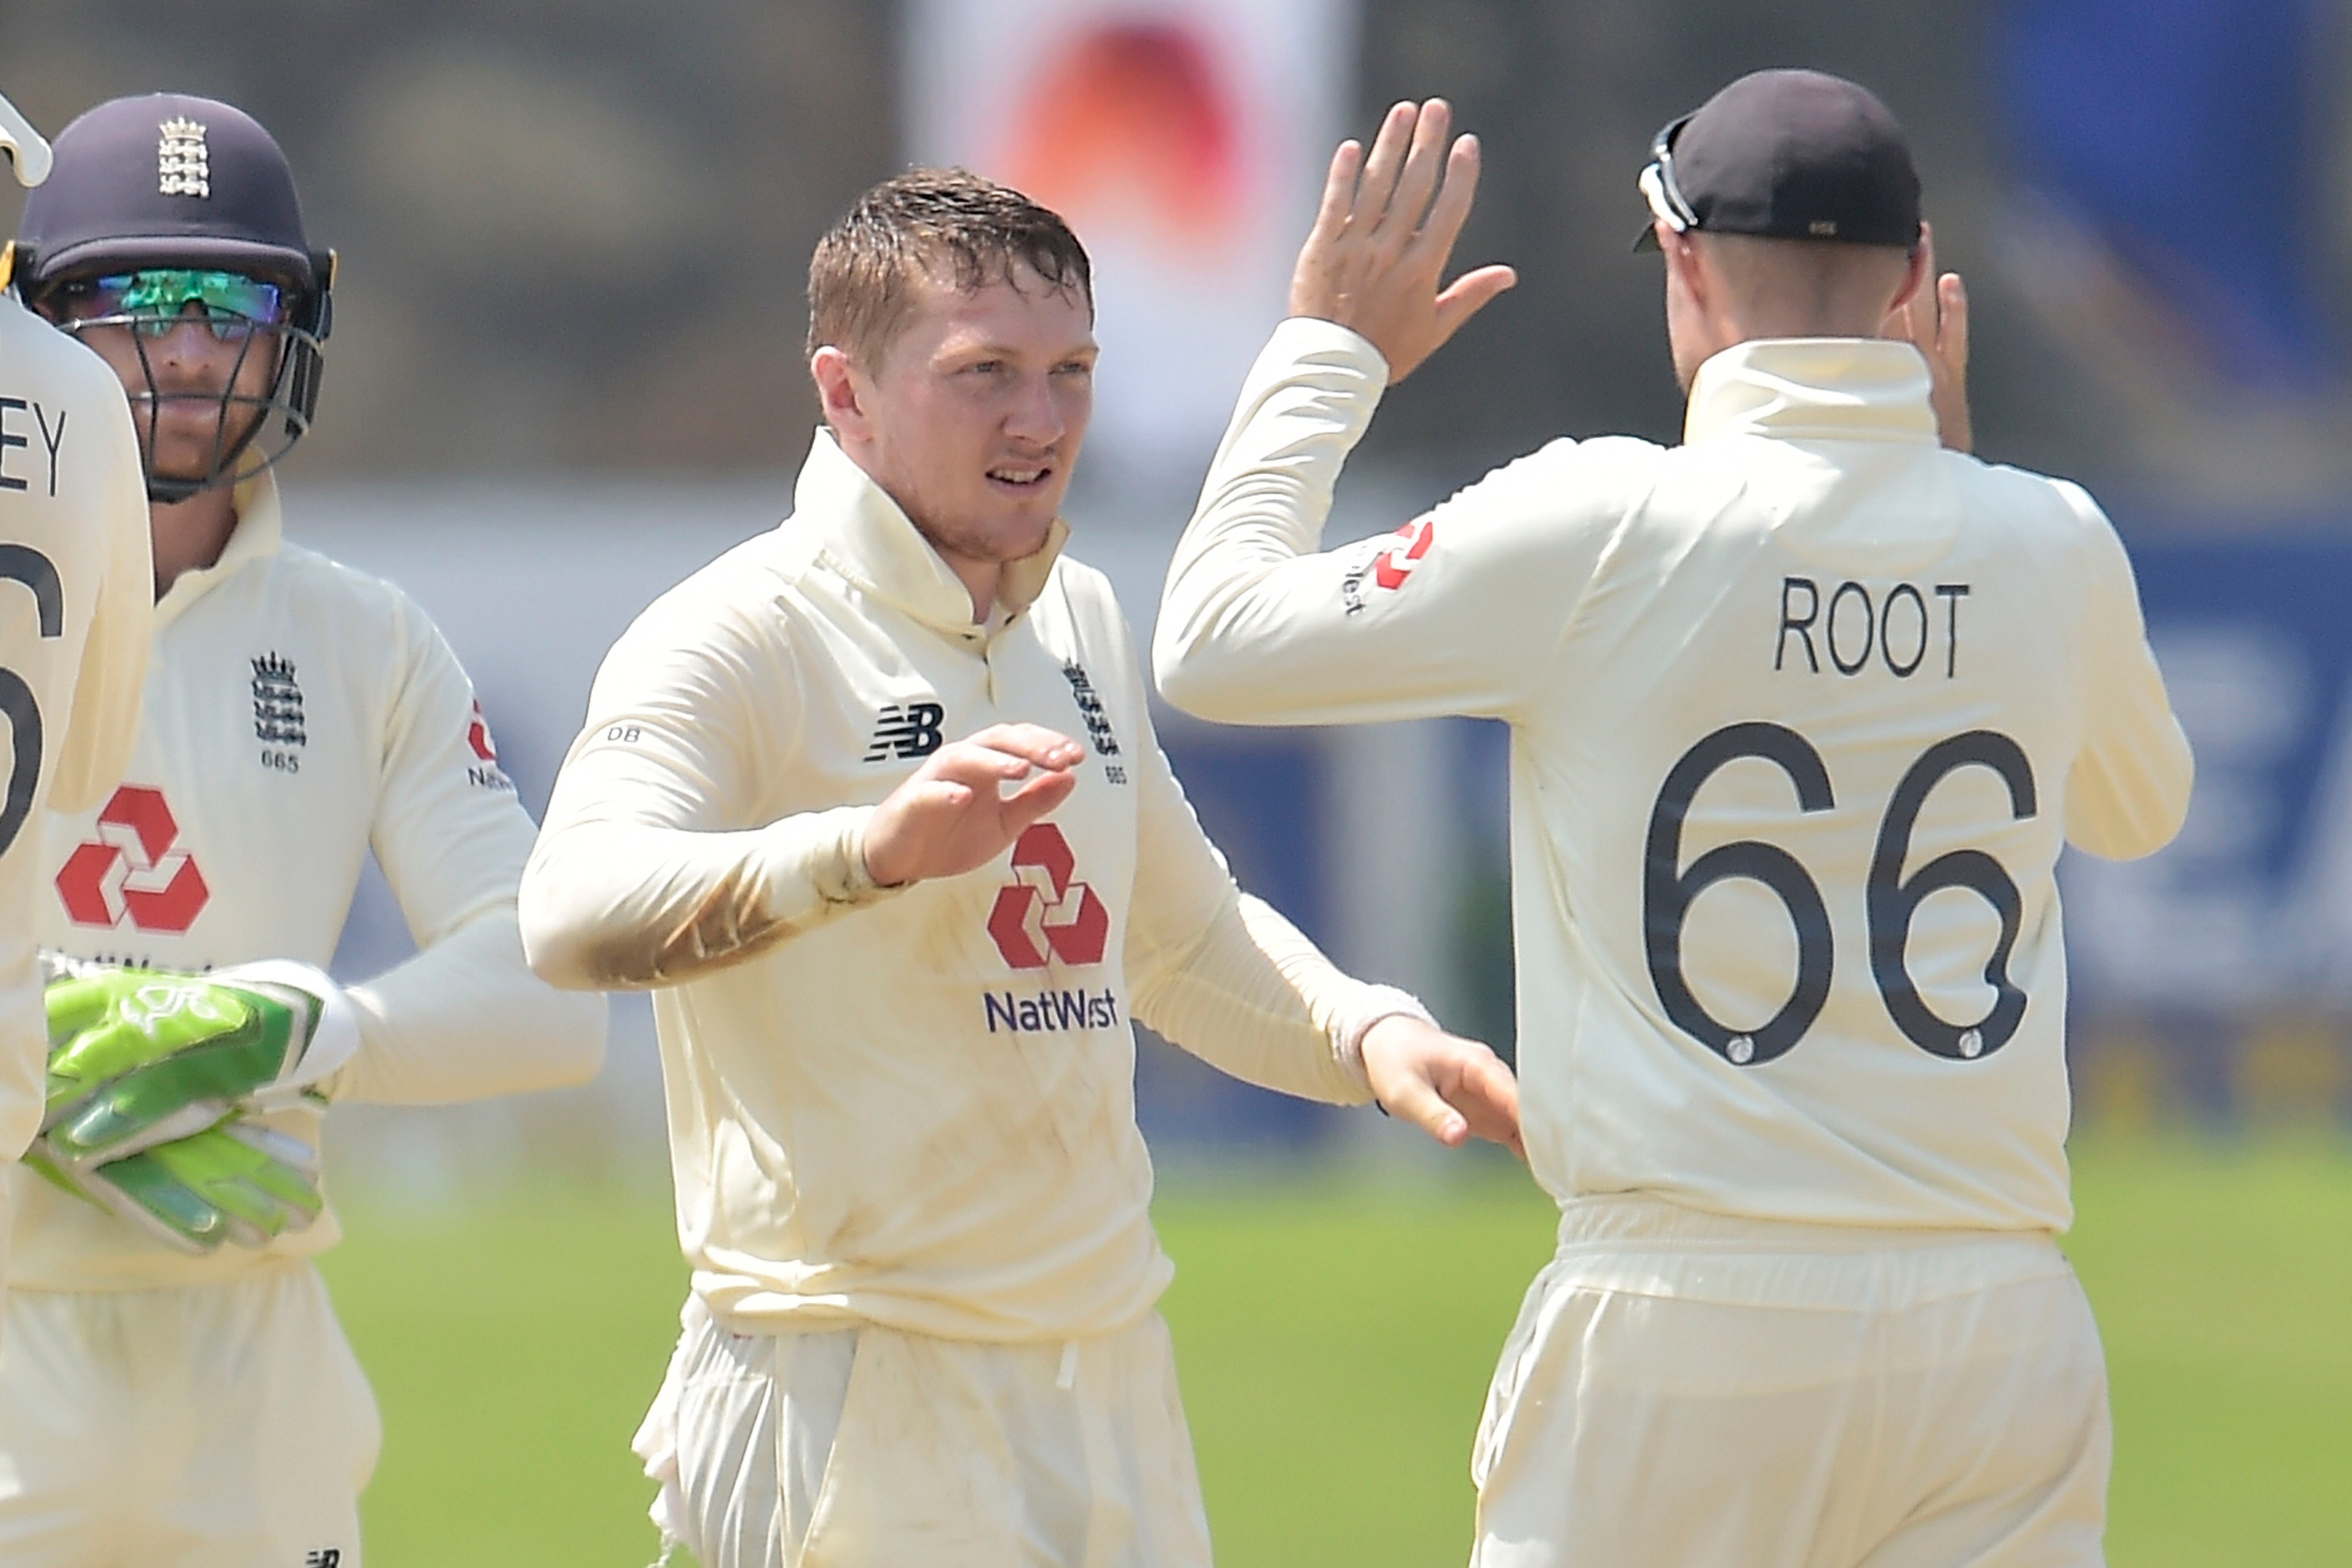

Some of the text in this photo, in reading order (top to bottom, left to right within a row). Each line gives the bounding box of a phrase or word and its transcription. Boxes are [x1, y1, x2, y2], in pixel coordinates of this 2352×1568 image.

[1775, 576, 1970, 679] ROOT
[608, 726, 640, 742] DB
[1643, 721, 2037, 1067] 66
